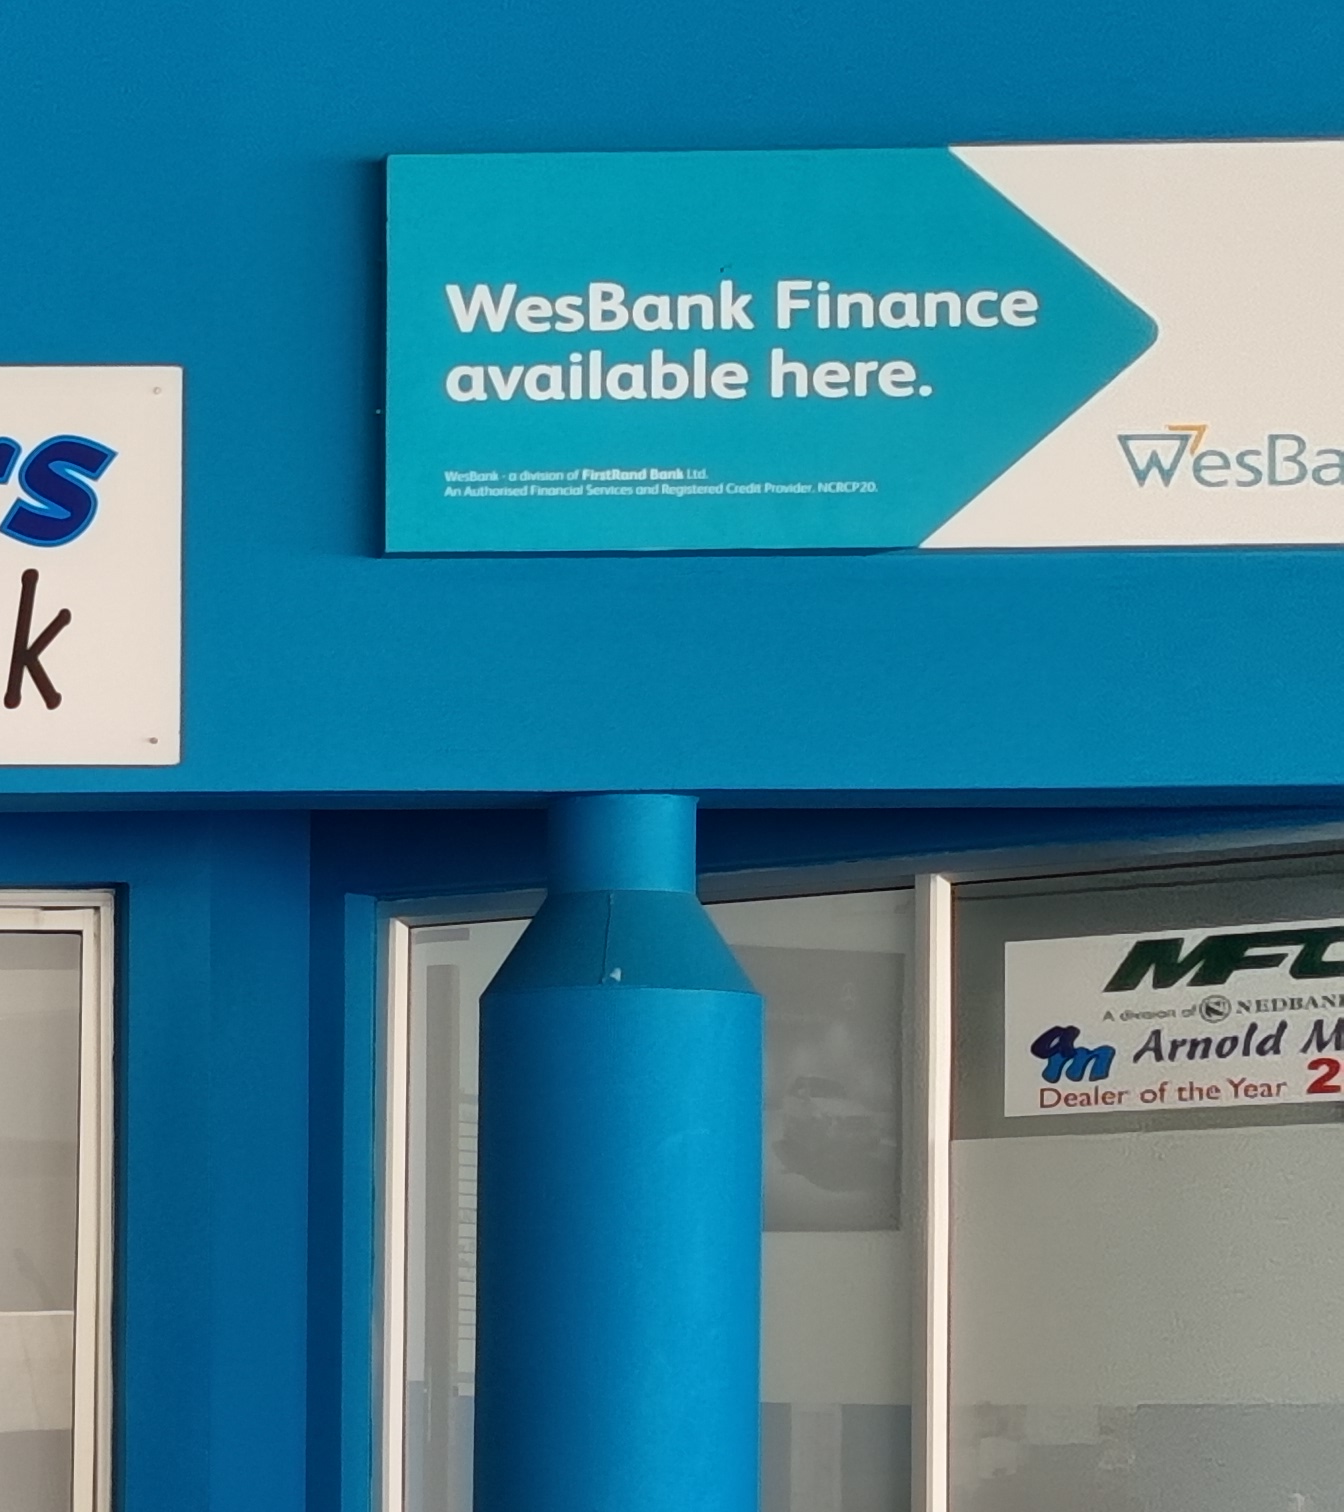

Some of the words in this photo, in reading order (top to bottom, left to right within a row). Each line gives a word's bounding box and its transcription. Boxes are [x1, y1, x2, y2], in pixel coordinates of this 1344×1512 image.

[444, 279, 754, 334] WesBank
[776, 279, 1040, 329] Finance
[444, 349, 748, 402] available
[769, 347, 934, 399] here.
[443, 470, 499, 482] WesBank
[519, 469, 564, 482] division
[566, 469, 579, 481] of
[581, 468, 647, 481] FirstRand
[649, 467, 684, 480] Bank
[443, 486, 461, 497] An
[463, 485, 528, 497] Authorised
[530, 484, 583, 496] Financial
[585, 484, 634, 496] Services
[635, 483, 659, 495] and
[661, 482, 724, 498] Registered
[725, 482, 762, 495] Credit
[1102, 1010, 1115, 1021] A
[1132, 1020, 1289, 1064] Arnold
[1039, 1085, 1129, 1109] Dealer
[1139, 1080, 1170, 1104] of
[1176, 1080, 1223, 1102] the
[1226, 1077, 1289, 1100] Year
